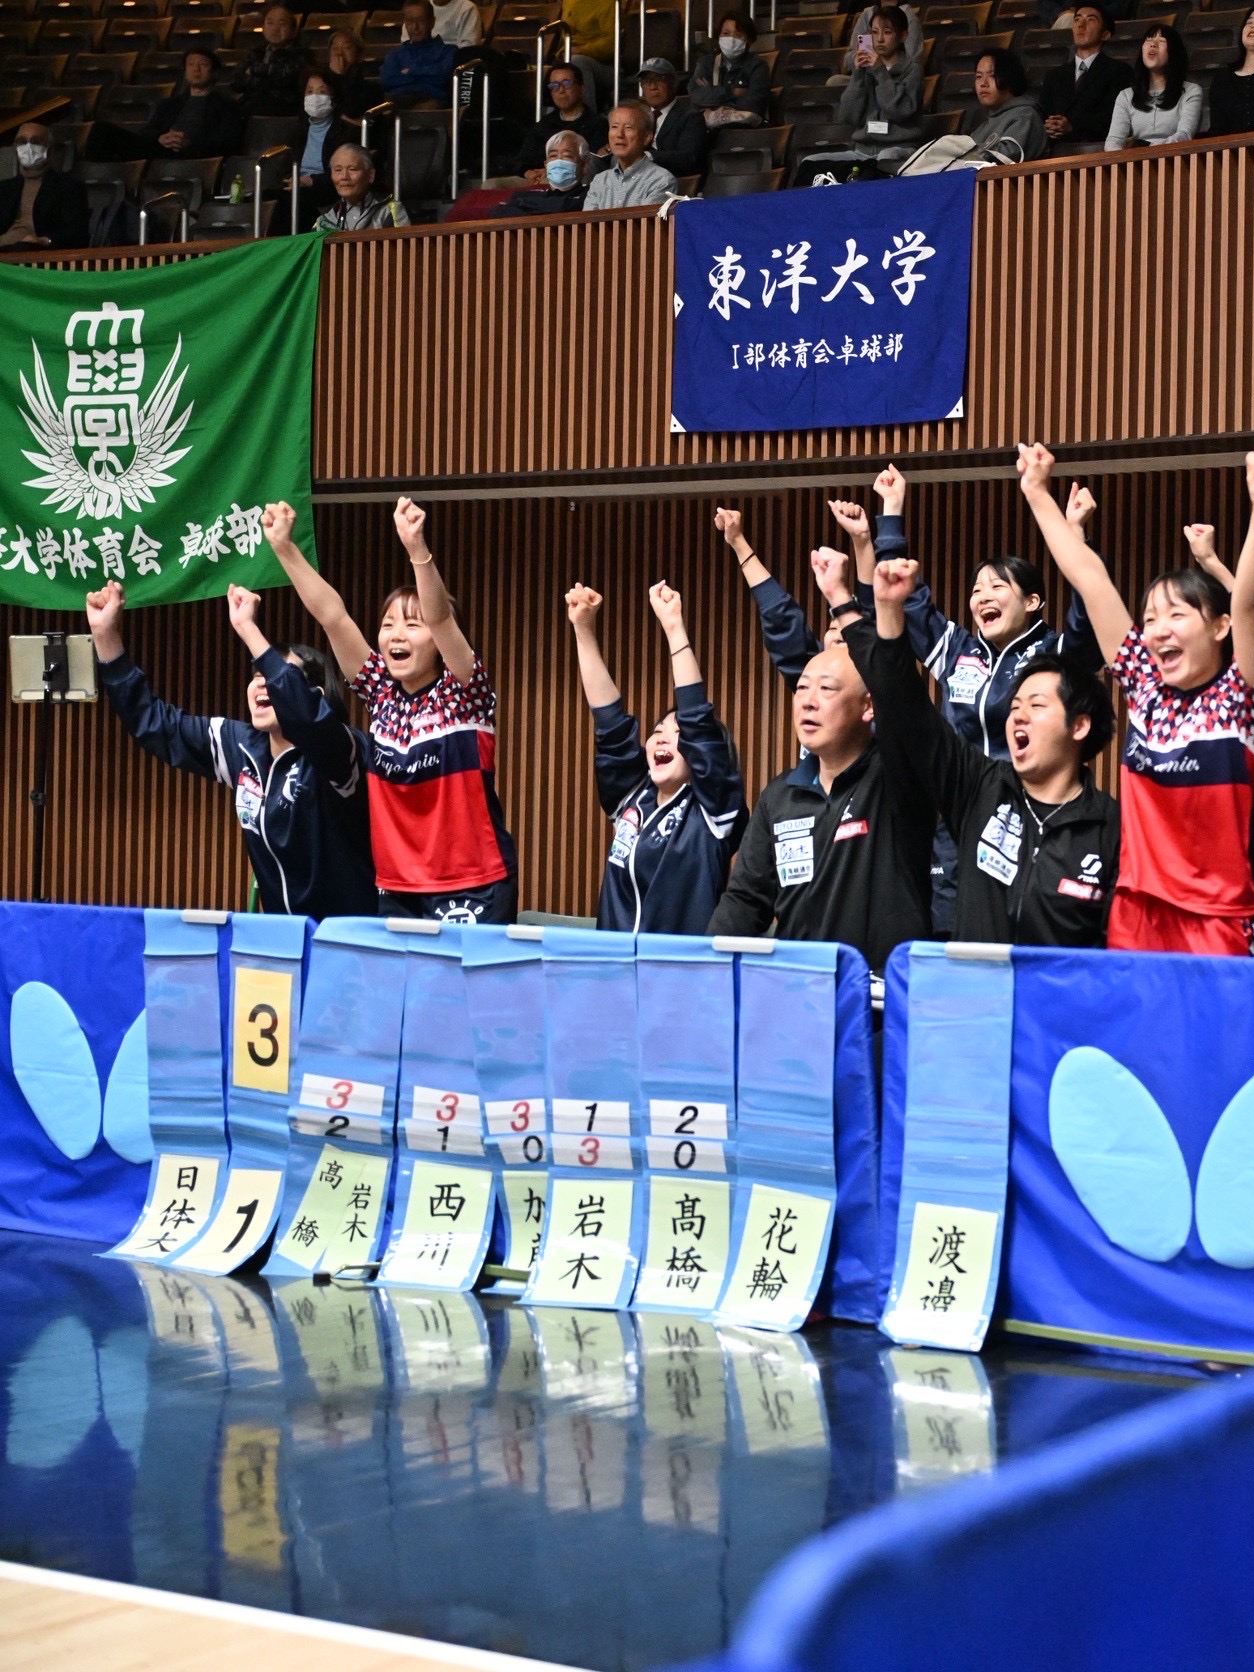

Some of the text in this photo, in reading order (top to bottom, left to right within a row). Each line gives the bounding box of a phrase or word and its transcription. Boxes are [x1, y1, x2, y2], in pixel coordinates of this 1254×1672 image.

[708, 229, 936, 321] 東洋大学
[435, 899, 484, 917] TOYO
[247, 1003, 280, 1068] 3
[326, 1080, 354, 1110] 3
[436, 1092, 460, 1122] 3
[324, 1115, 350, 1139] 2
[510, 1101, 531, 1132] 3
[584, 1102, 599, 1132] 1
[674, 1105, 699, 1135] 2
[436, 1126, 449, 1152] 1
[522, 1135, 544, 1163] 0
[578, 1136, 601, 1166] 3
[674, 1140, 697, 1170] 0
[139, 1166, 200, 1252] 日体大
[341, 1183, 372, 1243] 岩木
[222, 1199, 259, 1253] 1
[417, 1183, 467, 1271] 西川
[558, 1194, 606, 1290] 岩木
[746, 1206, 798, 1302] 花輪
